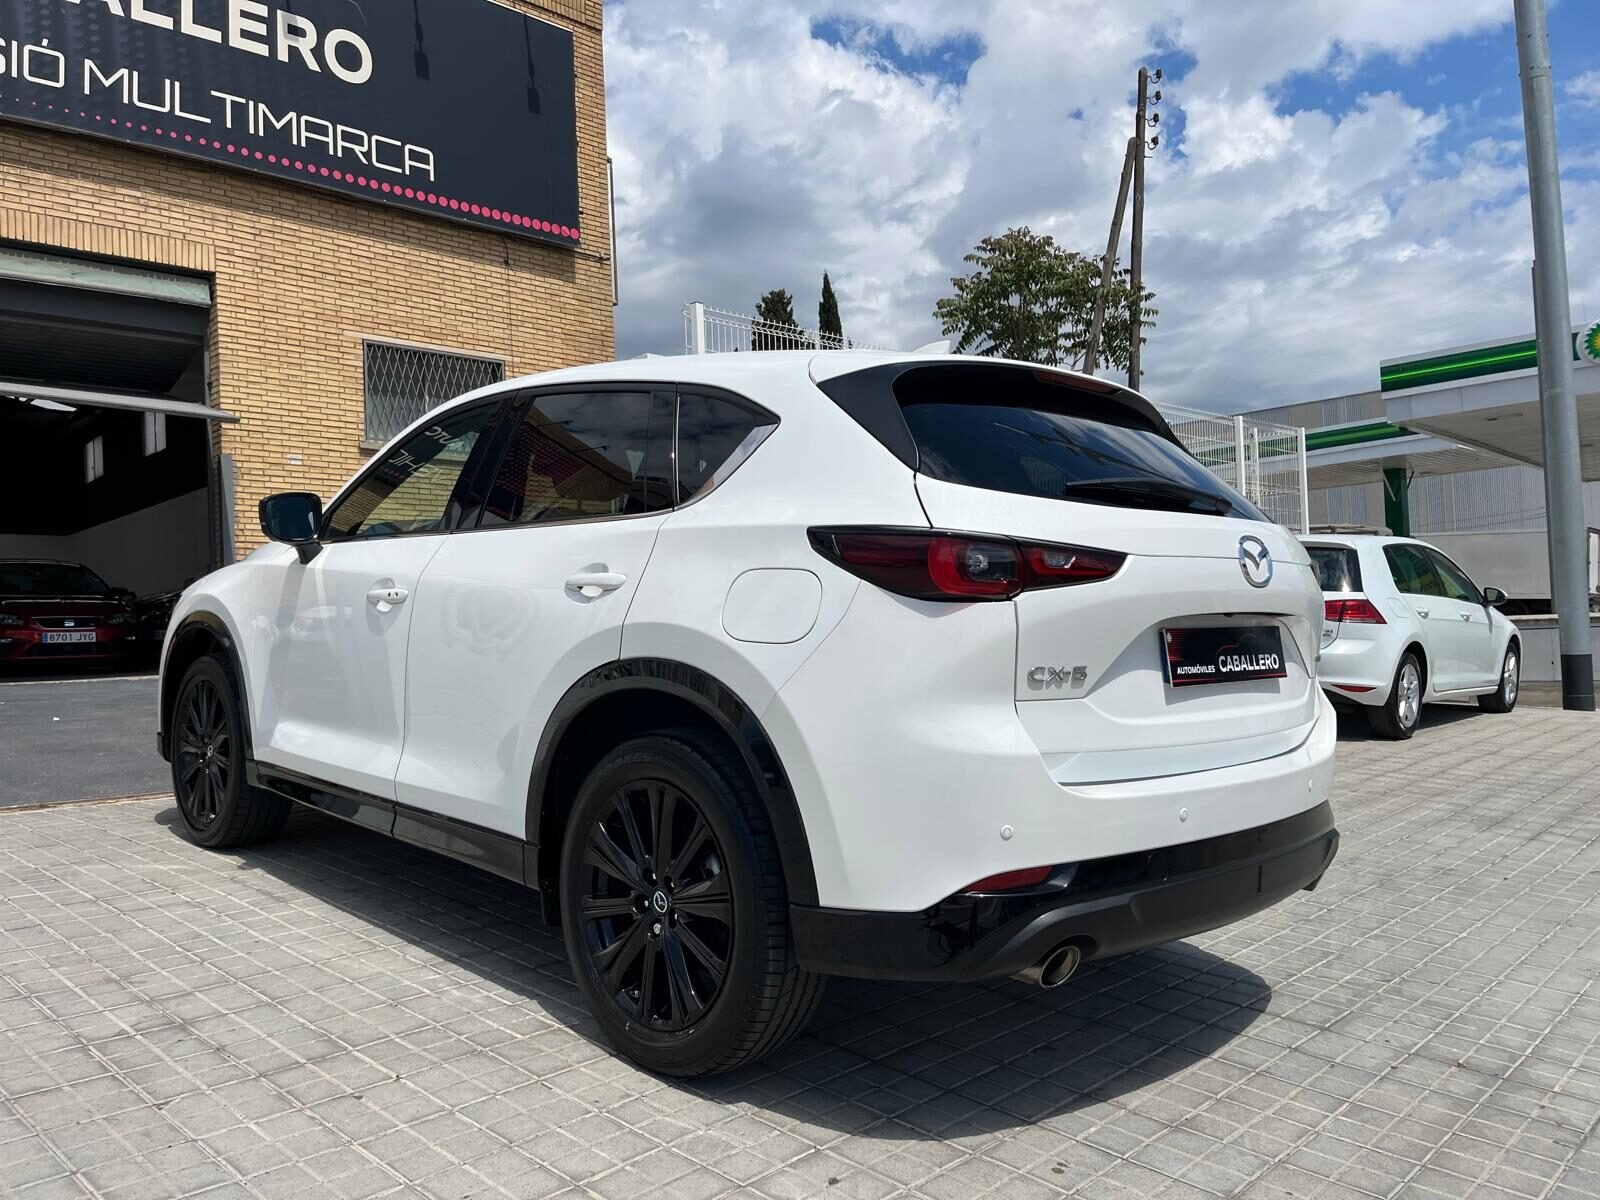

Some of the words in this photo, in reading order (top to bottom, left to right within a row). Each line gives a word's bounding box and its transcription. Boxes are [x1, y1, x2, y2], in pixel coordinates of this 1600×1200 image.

[66, 0, 373, 84] LLERO
[0, 38, 65, 88] IÓ
[84, 58, 434, 182] MULTIMARCA
[50, 633, 73, 641] 8701
[76, 632, 94, 641] JYG
[1026, 665, 1088, 682] CX-5
[1177, 664, 1215, 675] AUTOMÓVILES
[1218, 653, 1279, 672] CABALLERO
